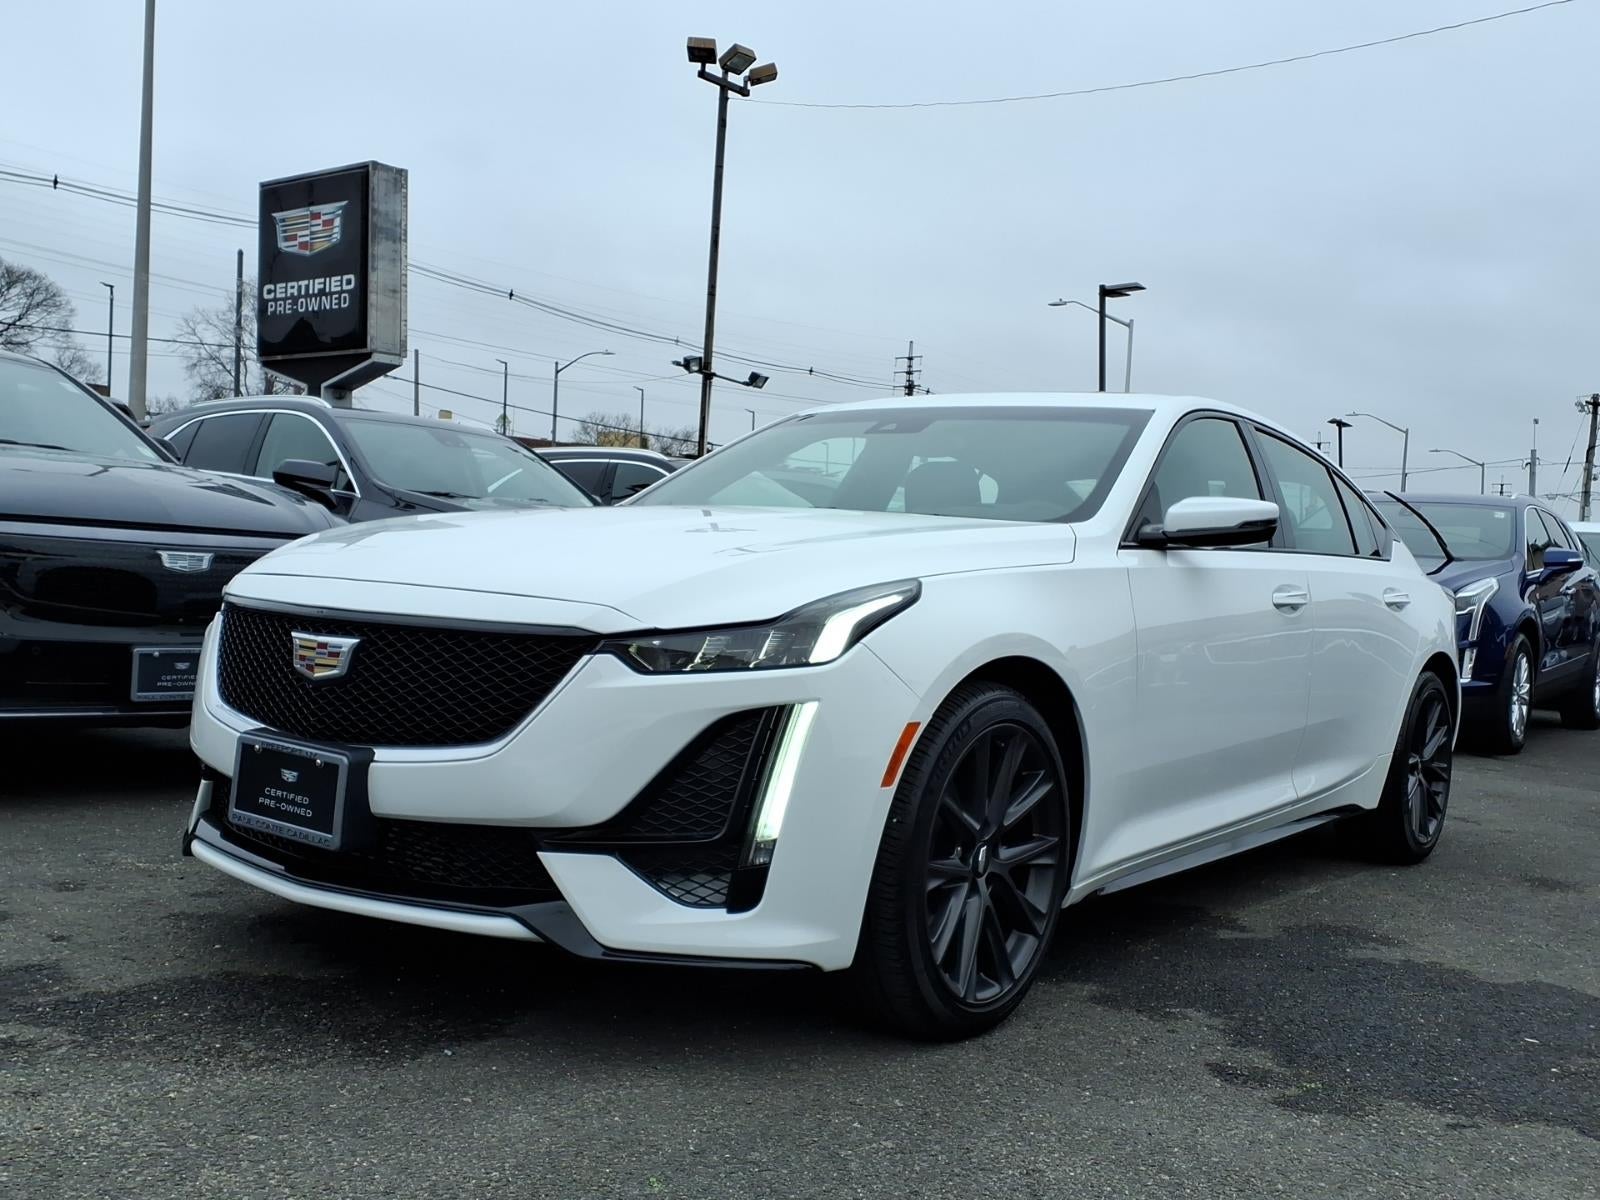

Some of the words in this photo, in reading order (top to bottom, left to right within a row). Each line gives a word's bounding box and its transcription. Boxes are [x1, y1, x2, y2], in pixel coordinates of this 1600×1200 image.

[263, 274, 355, 299] CERTIFIED
[268, 294, 349, 315] PRE-OWNED
[264, 787, 310, 805] CERTIFIED
[258, 797, 313, 817] PRE-OWNED
[287, 828, 331, 847] CADILLAC
